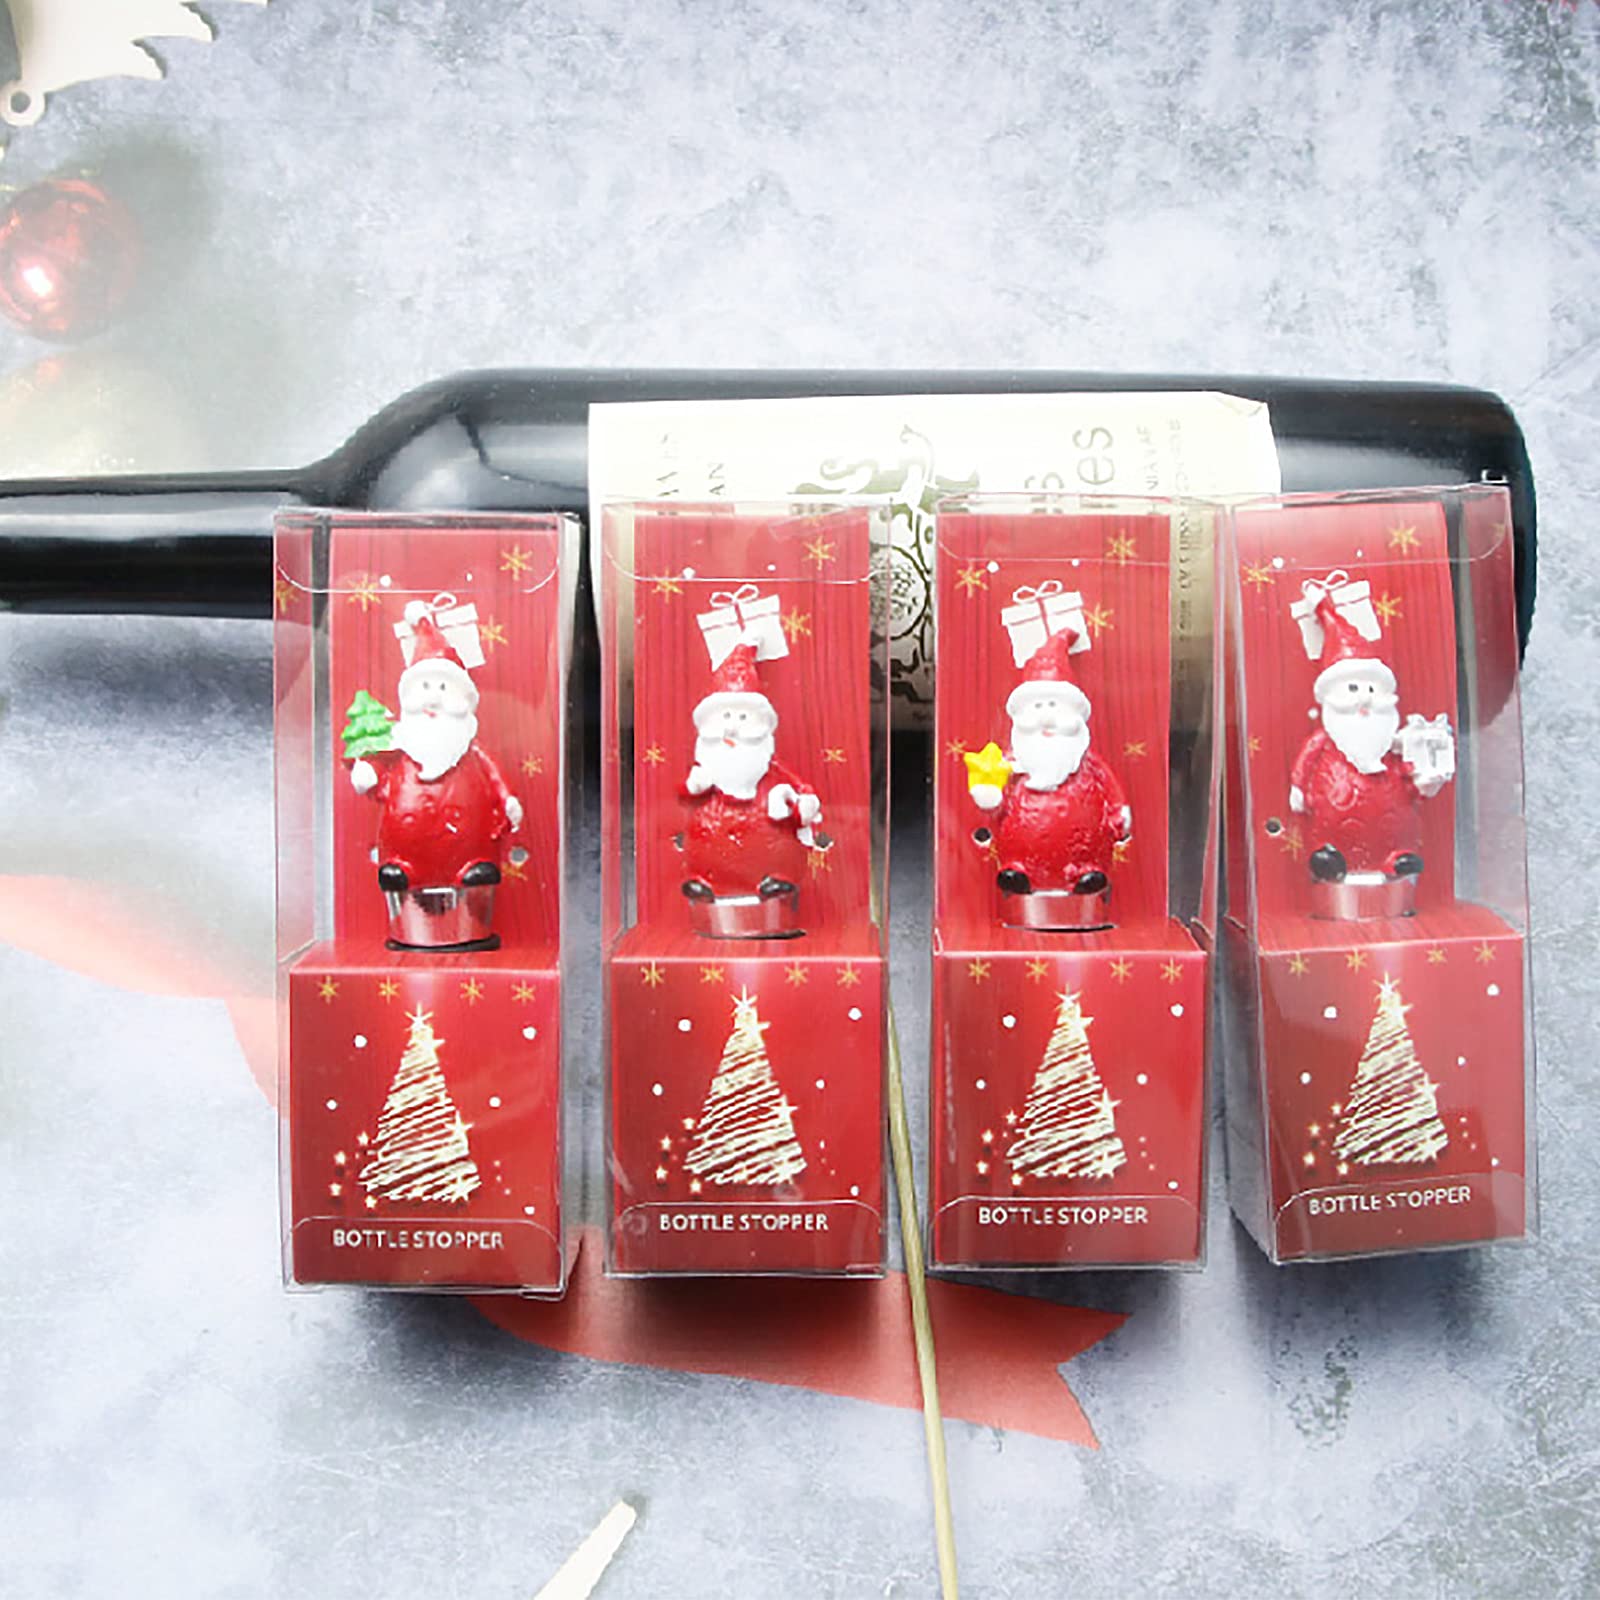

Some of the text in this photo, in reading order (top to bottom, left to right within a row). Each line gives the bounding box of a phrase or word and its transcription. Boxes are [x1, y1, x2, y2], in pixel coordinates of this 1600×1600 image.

[1308, 1185, 1471, 1216] BOTTLE STOPPER
[659, 1213, 829, 1232] BOTTLE STOPPER
[979, 1206, 1148, 1225] BOTTLE STOPPER
[332, 1229, 504, 1250] BOTTLE STOPPER
